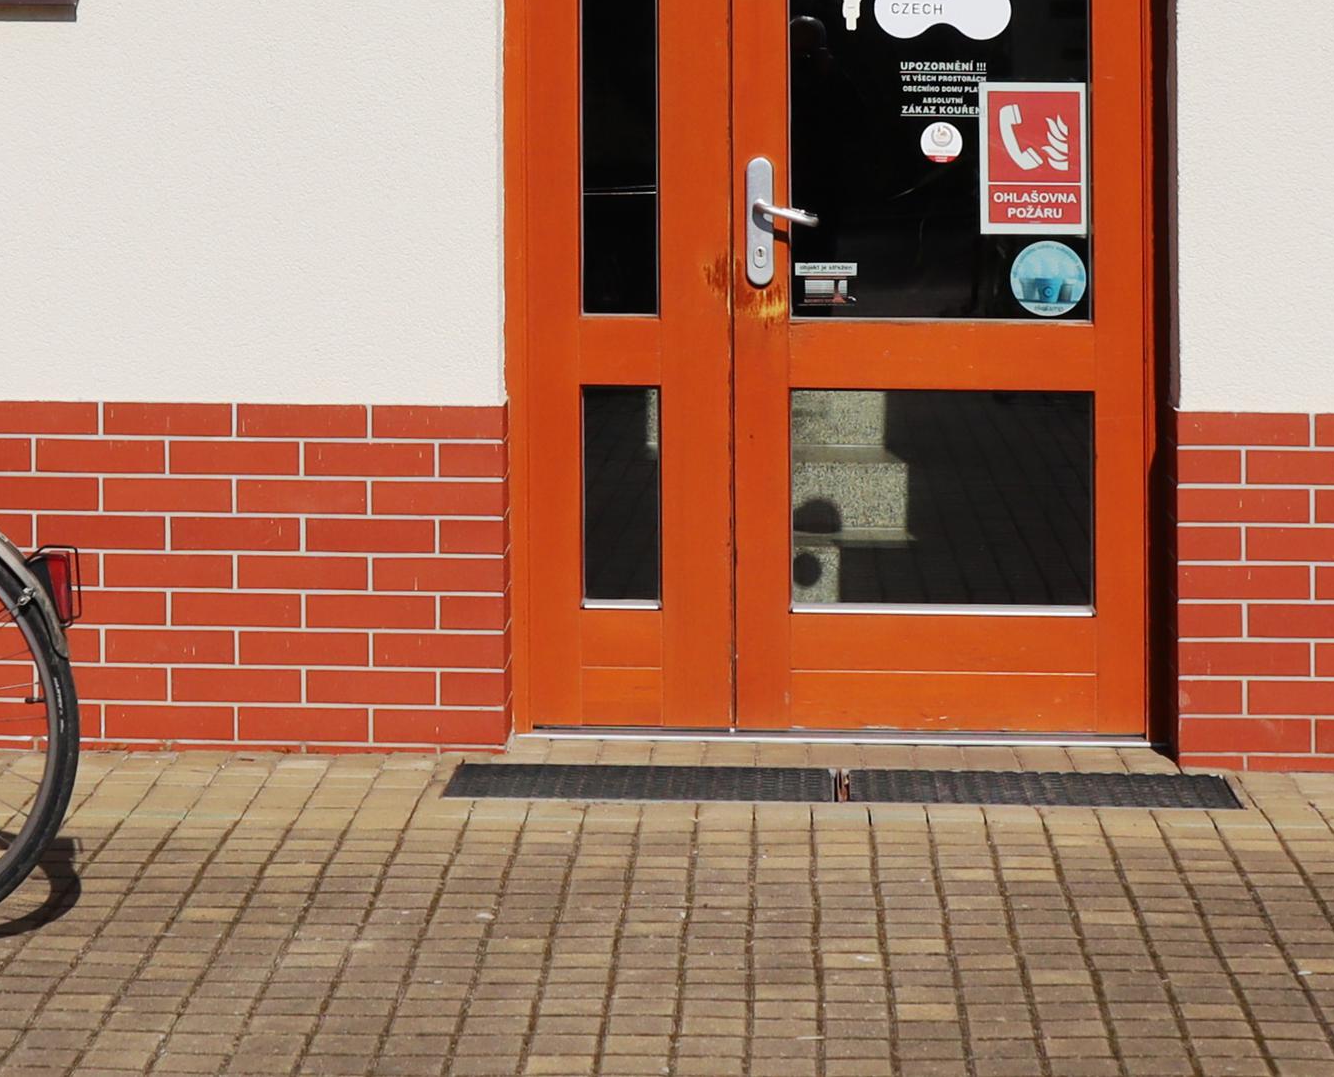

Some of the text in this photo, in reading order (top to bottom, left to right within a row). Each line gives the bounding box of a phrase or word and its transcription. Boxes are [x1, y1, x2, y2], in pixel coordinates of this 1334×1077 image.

[891, 3, 943, 15] CZECH
[900, 60, 987, 71] UPOZORNĚNÍ !!!
[912, 74, 937, 82] VŠECH
[903, 84, 940, 92] OBECNÍHO
[902, 103, 936, 113] ZÁKAZ
[993, 190, 1077, 203] OHLAŠOVNA
[1007, 205, 1063, 218] POŽÁRU
